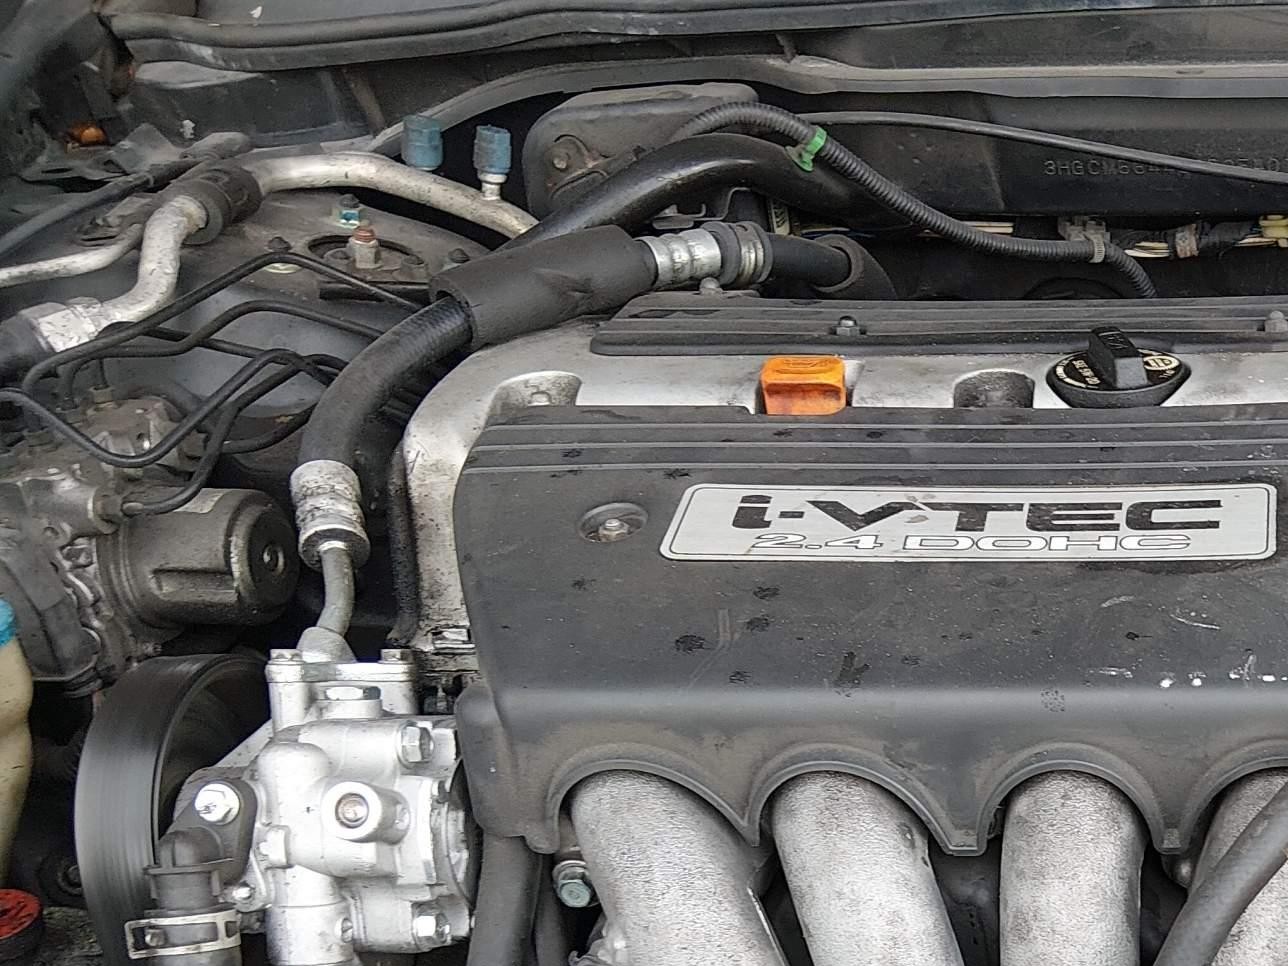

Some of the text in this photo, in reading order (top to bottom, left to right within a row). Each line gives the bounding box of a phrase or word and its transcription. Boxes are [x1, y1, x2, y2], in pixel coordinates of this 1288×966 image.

[731, 494, 1223, 532] i-VTEC
[750, 533, 1192, 552] 2.4 DOHC
